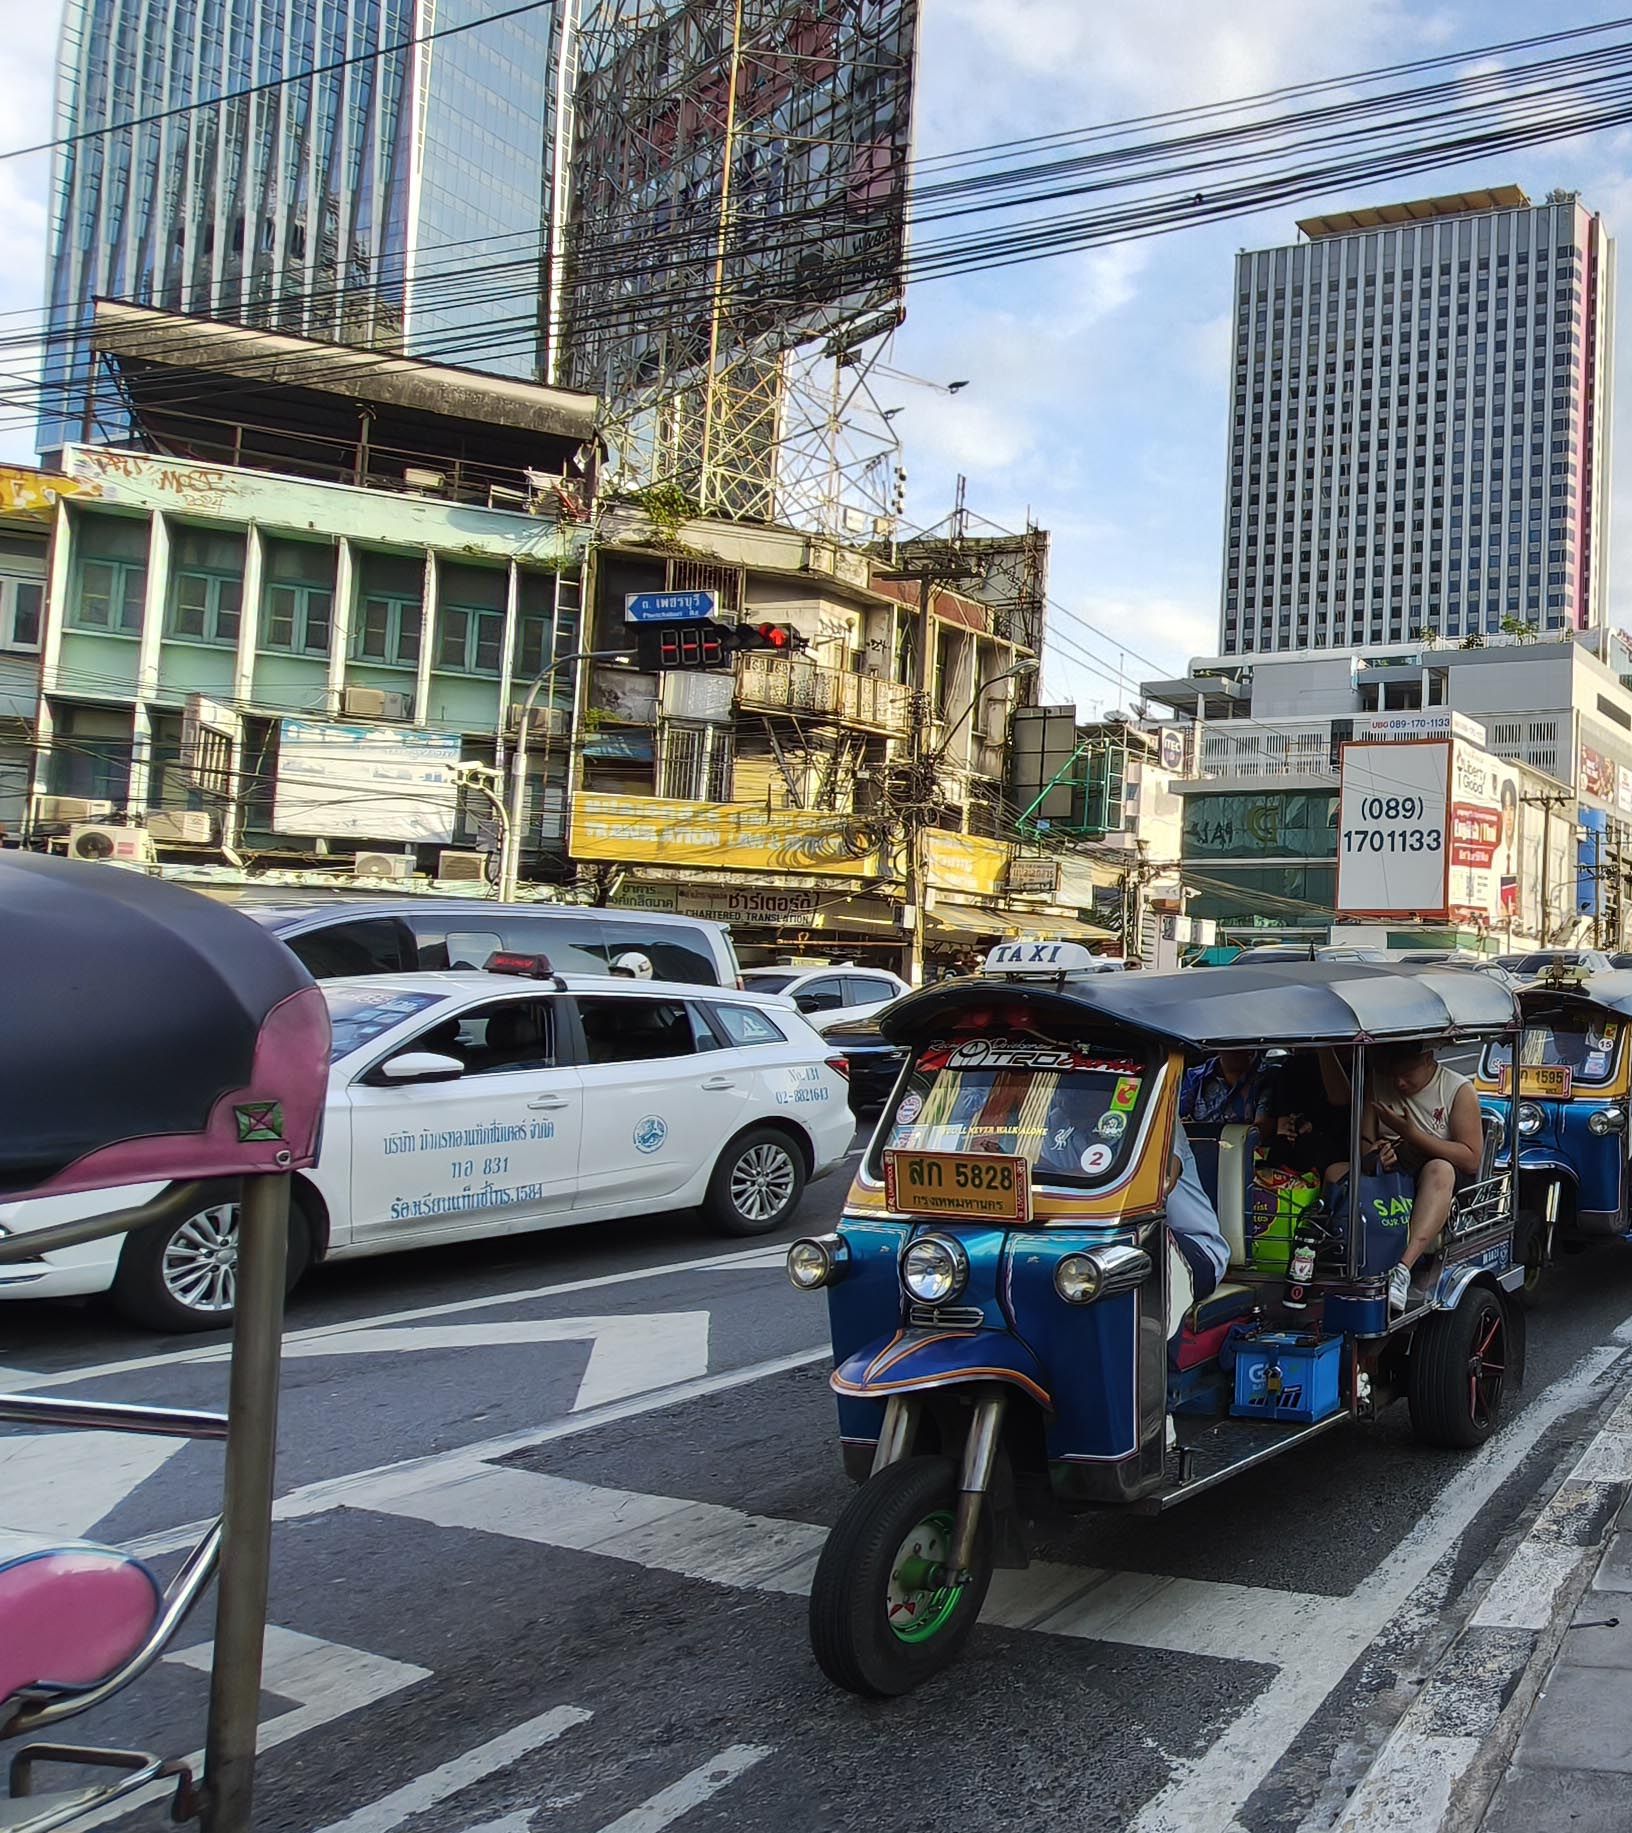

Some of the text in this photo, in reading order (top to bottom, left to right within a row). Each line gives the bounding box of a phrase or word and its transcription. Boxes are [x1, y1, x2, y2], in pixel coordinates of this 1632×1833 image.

[1389, 718, 1450, 729] 089-170-1133
[1361, 796, 1424, 821] (089)
[1343, 830, 1442, 852] 1701133
[686, 908, 811, 925] CHARTERED TRANSLATION
[996, 945, 1062, 962] TAXI
[1600, 1040, 1612, 1048] 15
[1536, 1071, 1564, 1084] 1595
[384, 1132, 416, 1155] บริษัท
[1089, 1151, 1104, 1166] 2
[909, 1158, 1013, 1191] สก 5828
[913, 1194, 1004, 1210] กรุงเทพมหานคร
